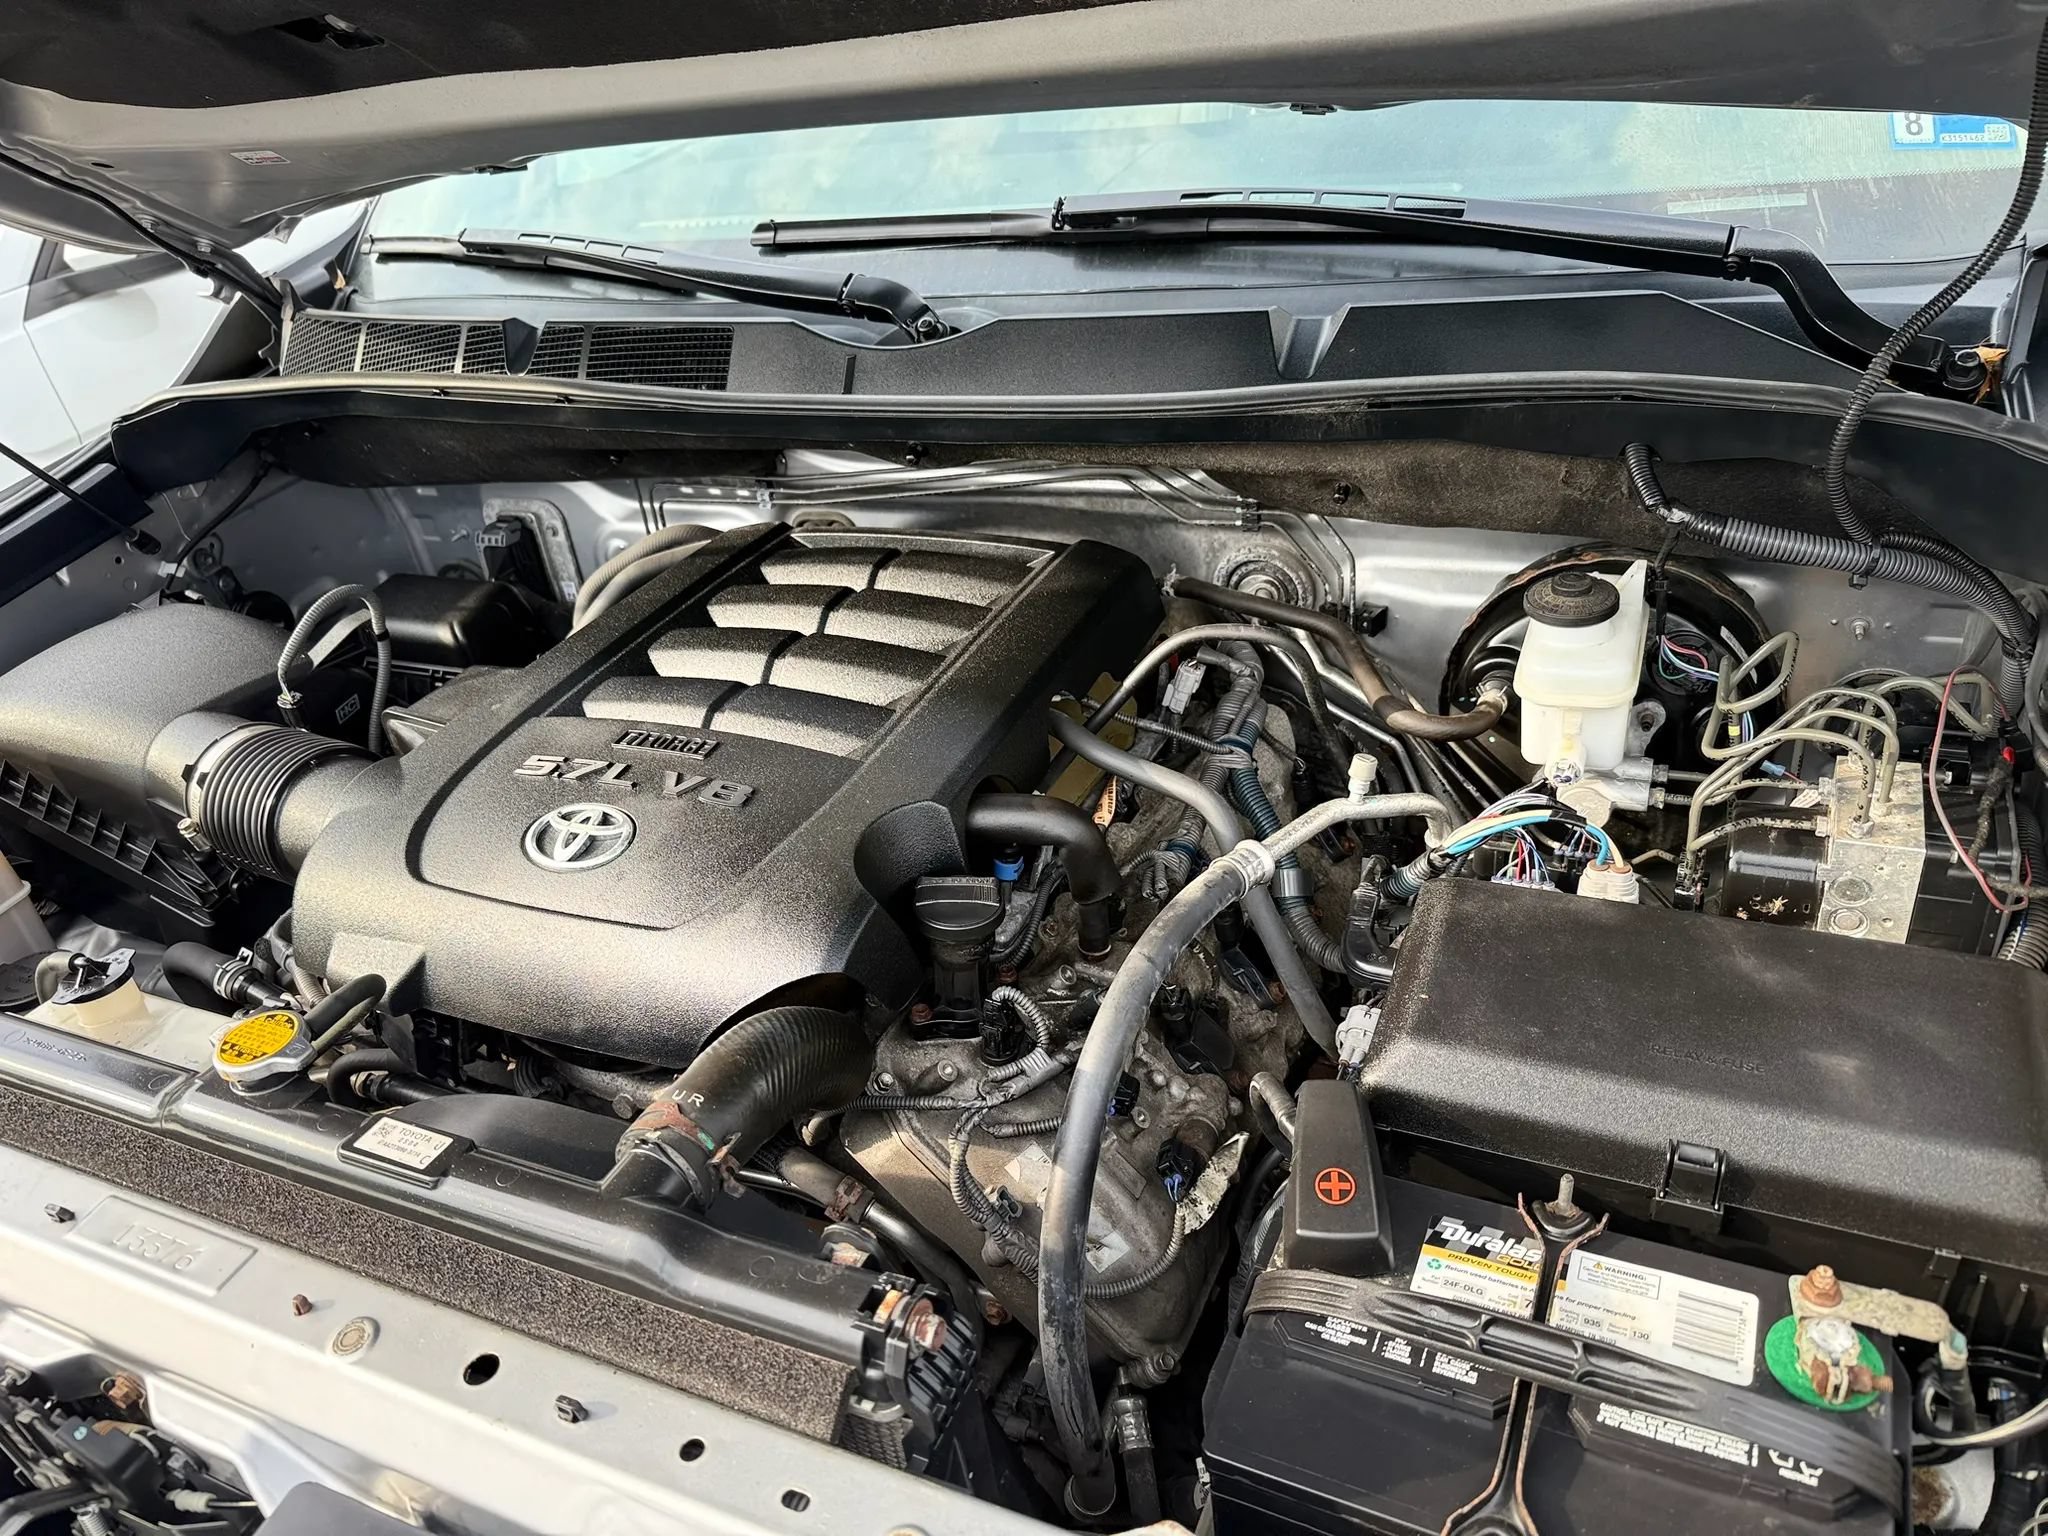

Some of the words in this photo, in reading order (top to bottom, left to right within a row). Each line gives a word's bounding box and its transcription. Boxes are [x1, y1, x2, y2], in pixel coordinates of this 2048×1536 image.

[514, 754, 638, 790] 5.7L
[663, 769, 754, 807] V8
[400, 1127, 433, 1144] TOYOTA
[1440, 1221, 1542, 1262] Duralas
[1444, 1264, 1469, 1276] Return
[1469, 1271, 1487, 1281] used
[1487, 1275, 1520, 1290] batteries
[1447, 1252, 1493, 1269] PROVEN
[1494, 1266, 1535, 1281] TOUGH
[1576, 1300, 1602, 1312] proper
[1602, 1306, 1637, 1321] recycling
[1583, 1317, 1602, 1329] 935
[1631, 1329, 1650, 1341] 130
